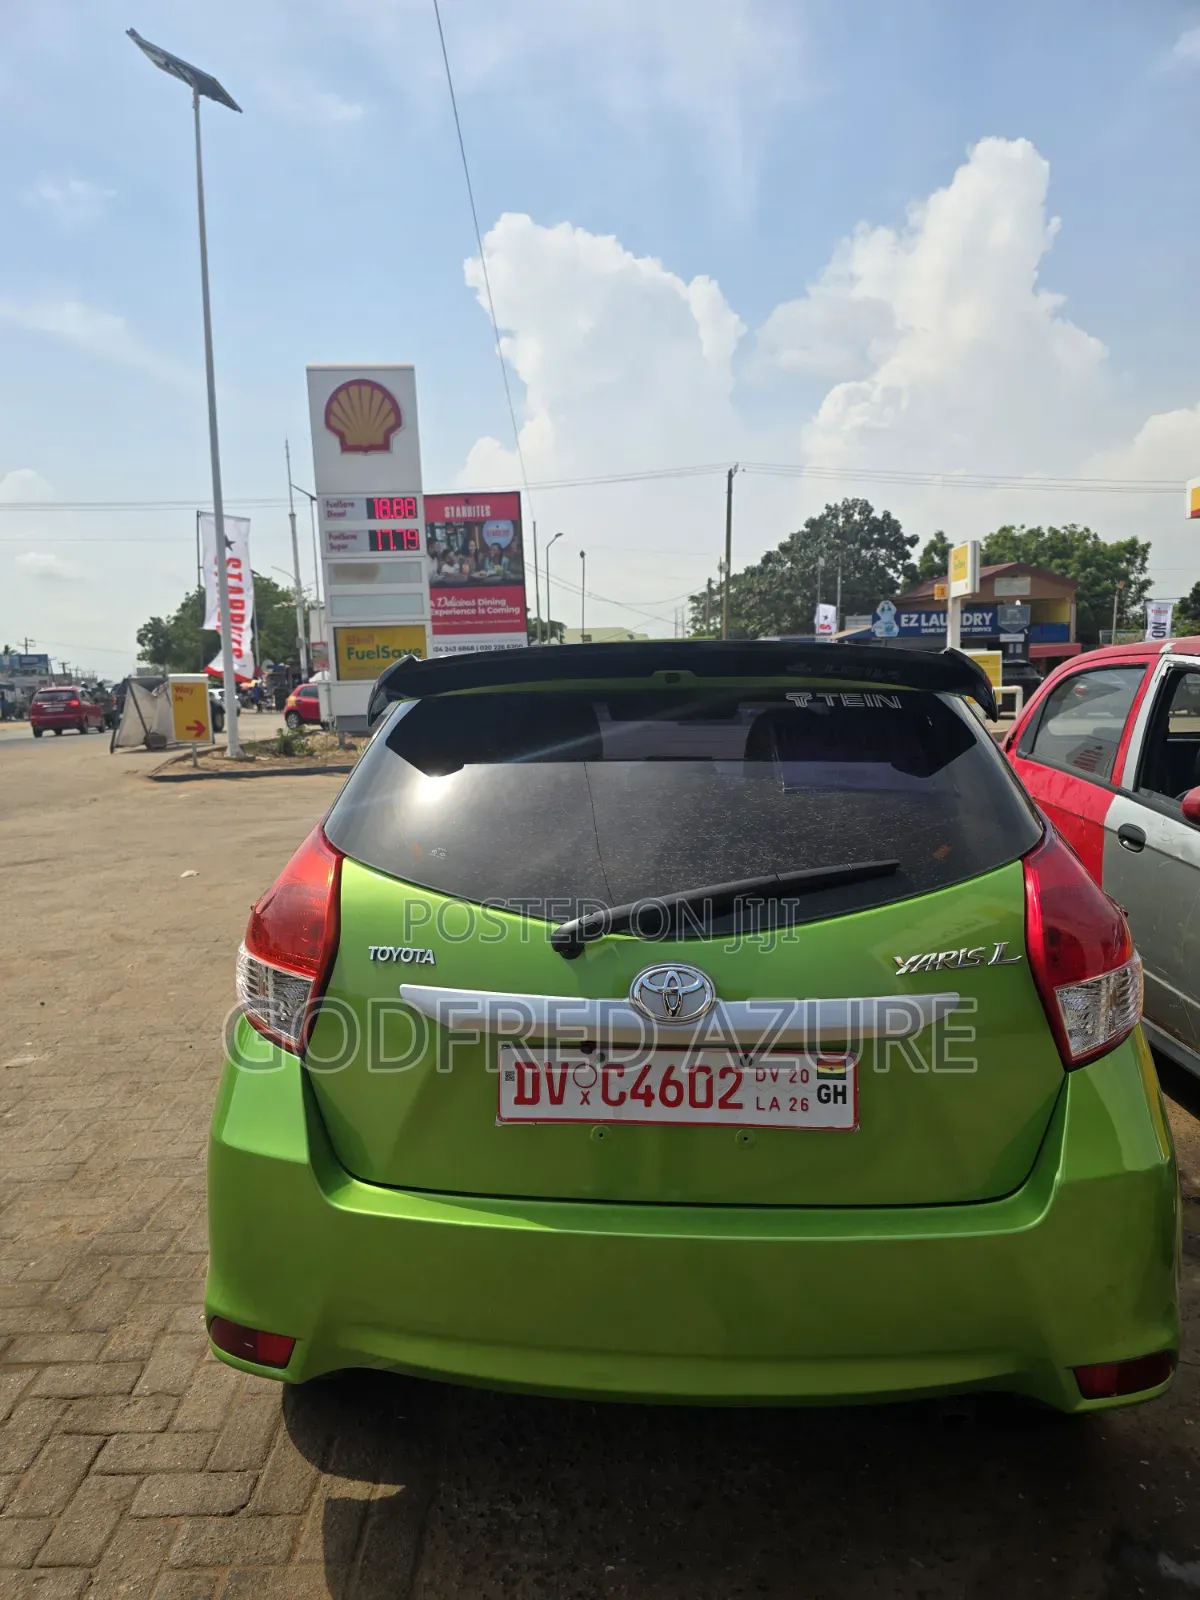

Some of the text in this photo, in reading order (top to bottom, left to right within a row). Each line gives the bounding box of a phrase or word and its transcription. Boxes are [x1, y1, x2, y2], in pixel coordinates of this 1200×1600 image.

[327, 510, 347, 518] Diesel
[444, 505, 491, 518] STARBITES
[329, 543, 348, 551] Super
[437, 596, 475, 608] Delicious
[478, 598, 506, 607] Dining
[430, 608, 476, 617] Experience
[487, 605, 520, 615] Coming
[900, 612, 993, 627] EZ LAUDRY
[347, 644, 422, 660] FuelSave
[173, 685, 194, 696] Way
[816, 692, 903, 709] TEIN
[368, 944, 436, 965] TOYOTA
[893, 941, 1023, 976] YARIS L
[755, 1067, 810, 1084] DV 20
[513, 1061, 569, 1105] DV
[601, 1063, 744, 1110] C4602
[816, 1083, 847, 1105] GH
[755, 1096, 810, 1112] LA 26
